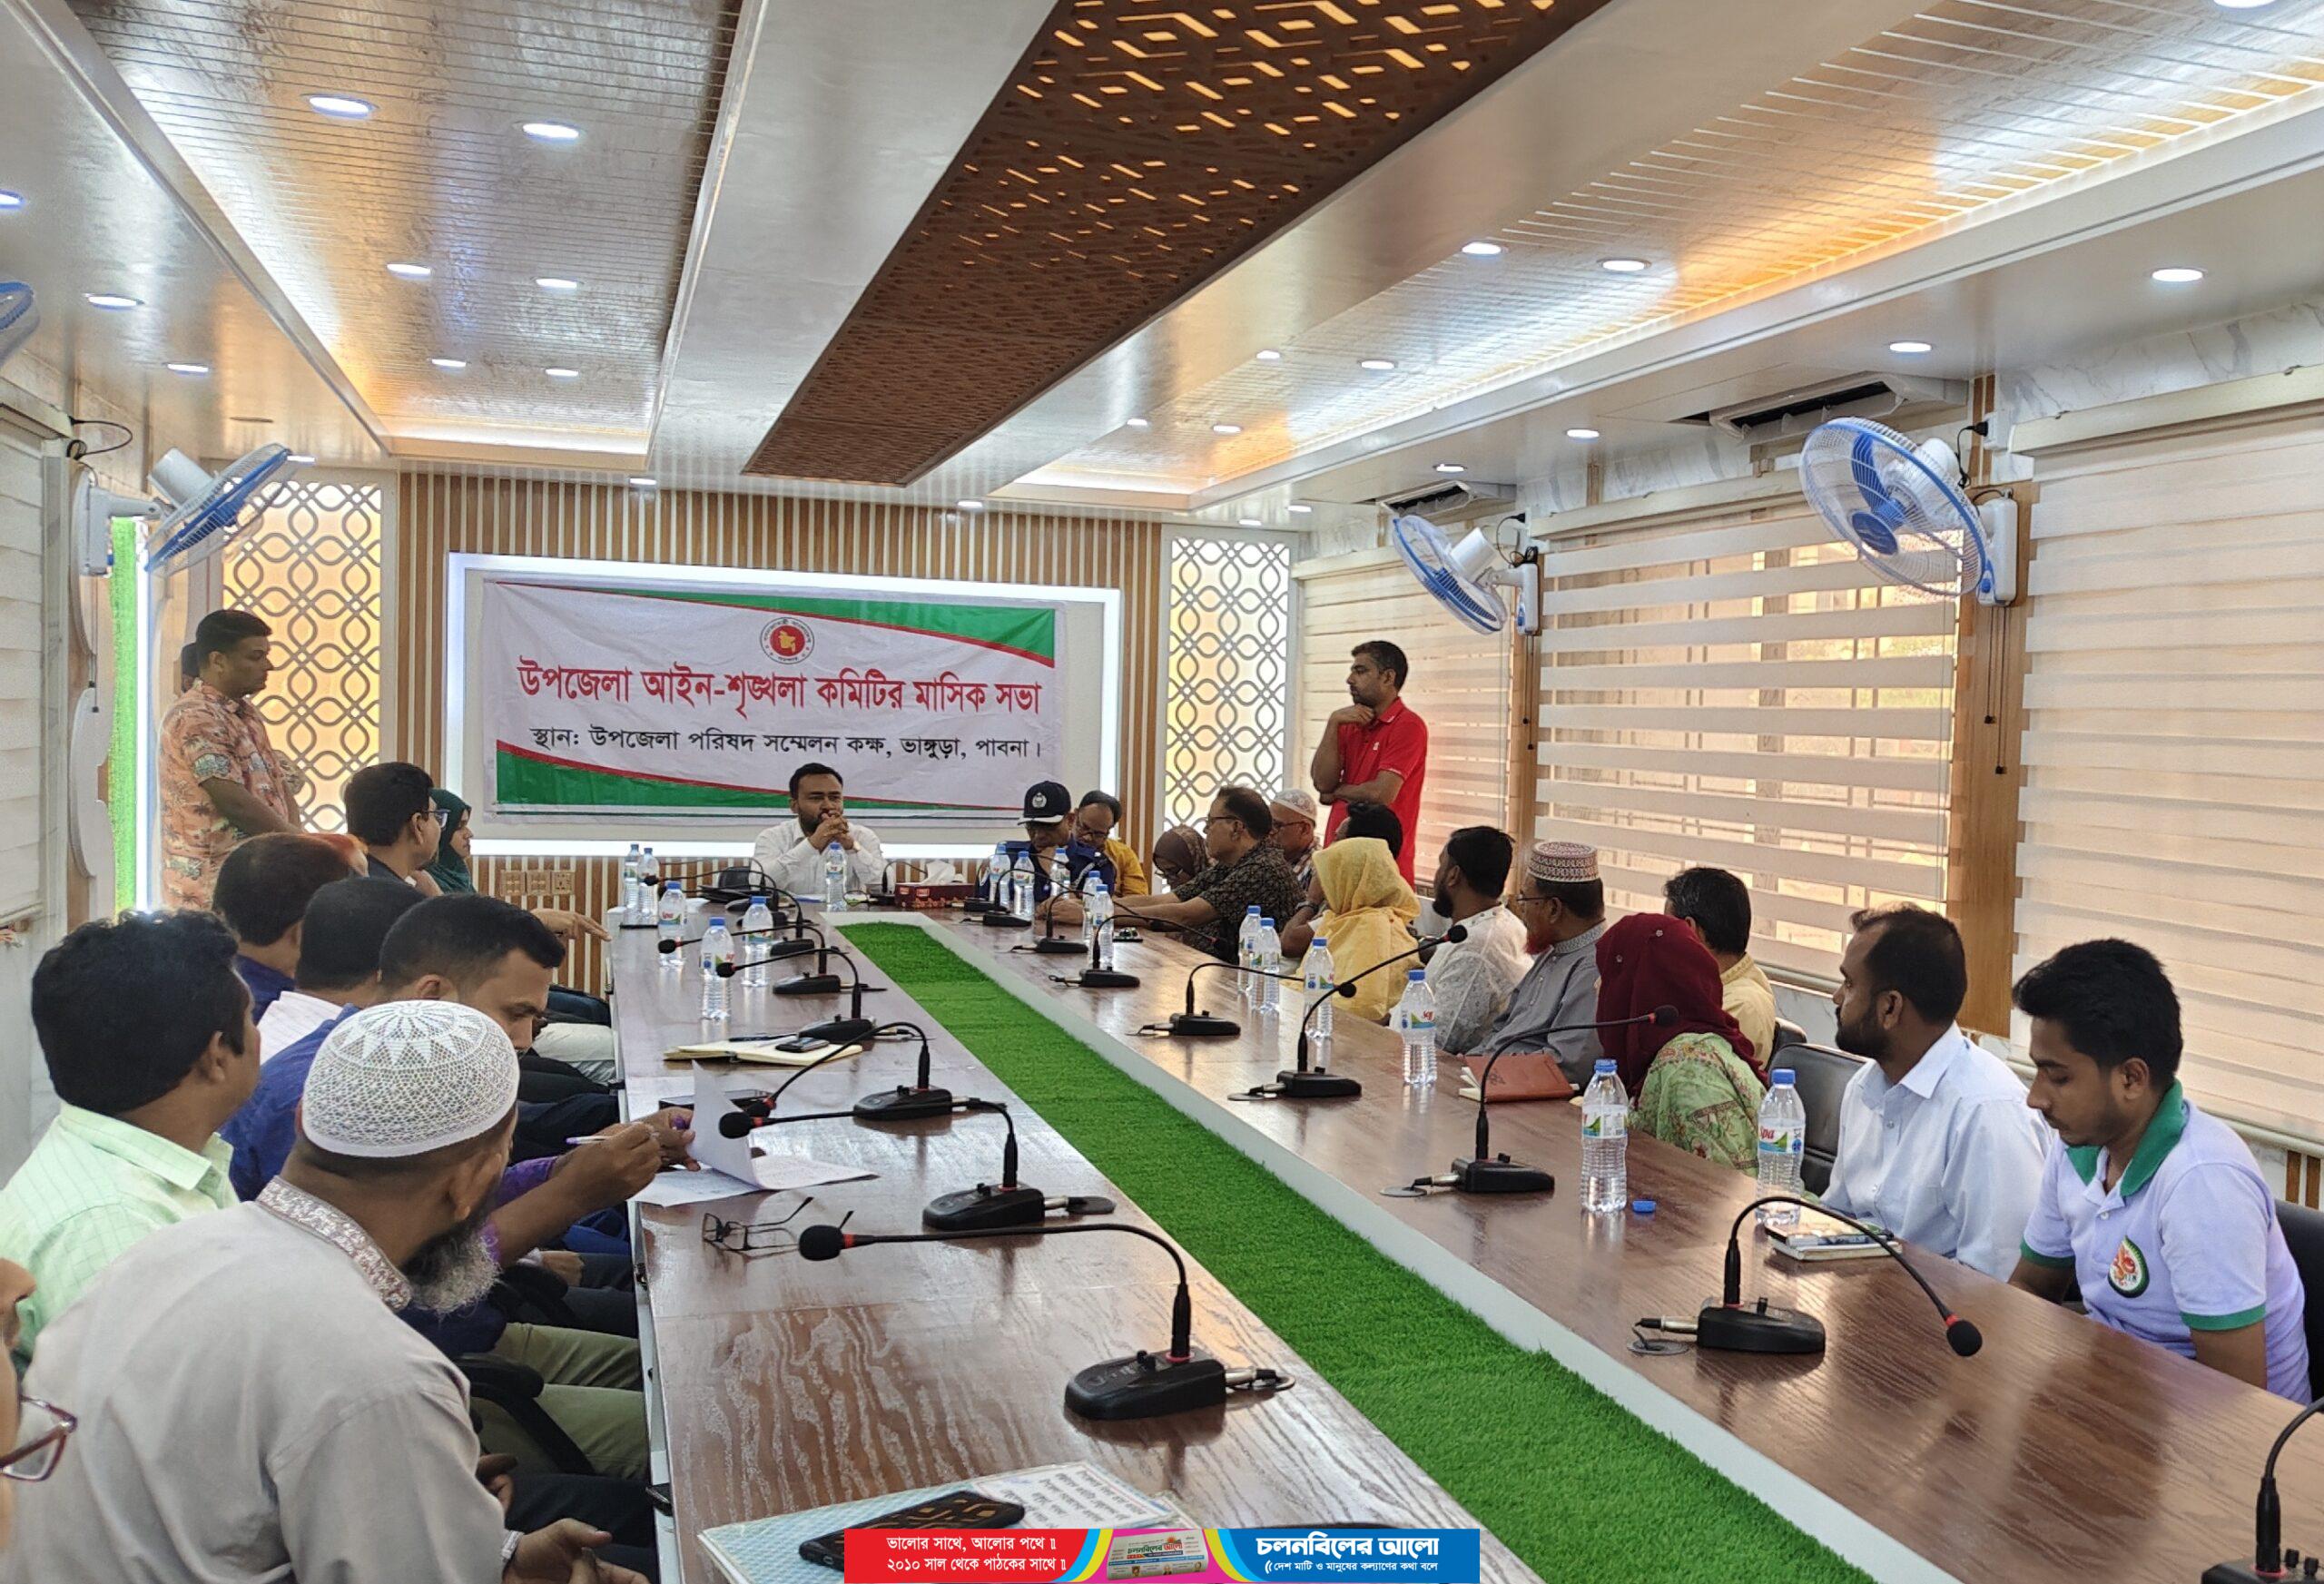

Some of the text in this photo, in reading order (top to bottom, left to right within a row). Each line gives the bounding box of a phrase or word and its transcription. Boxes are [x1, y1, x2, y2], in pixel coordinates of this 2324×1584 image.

[517, 654, 1042, 720] উপজেলা আইন-শৃঙ্খলা কমিটির মাসিক সভা
[588, 723, 680, 750] উপজেলা
[688, 728, 755, 752] পরিষদ
[763, 733, 840, 753] সম্মেলন
[845, 736, 892, 758] কক্ষ,
[900, 736, 967, 760] ভাঙ্গুড়া,
